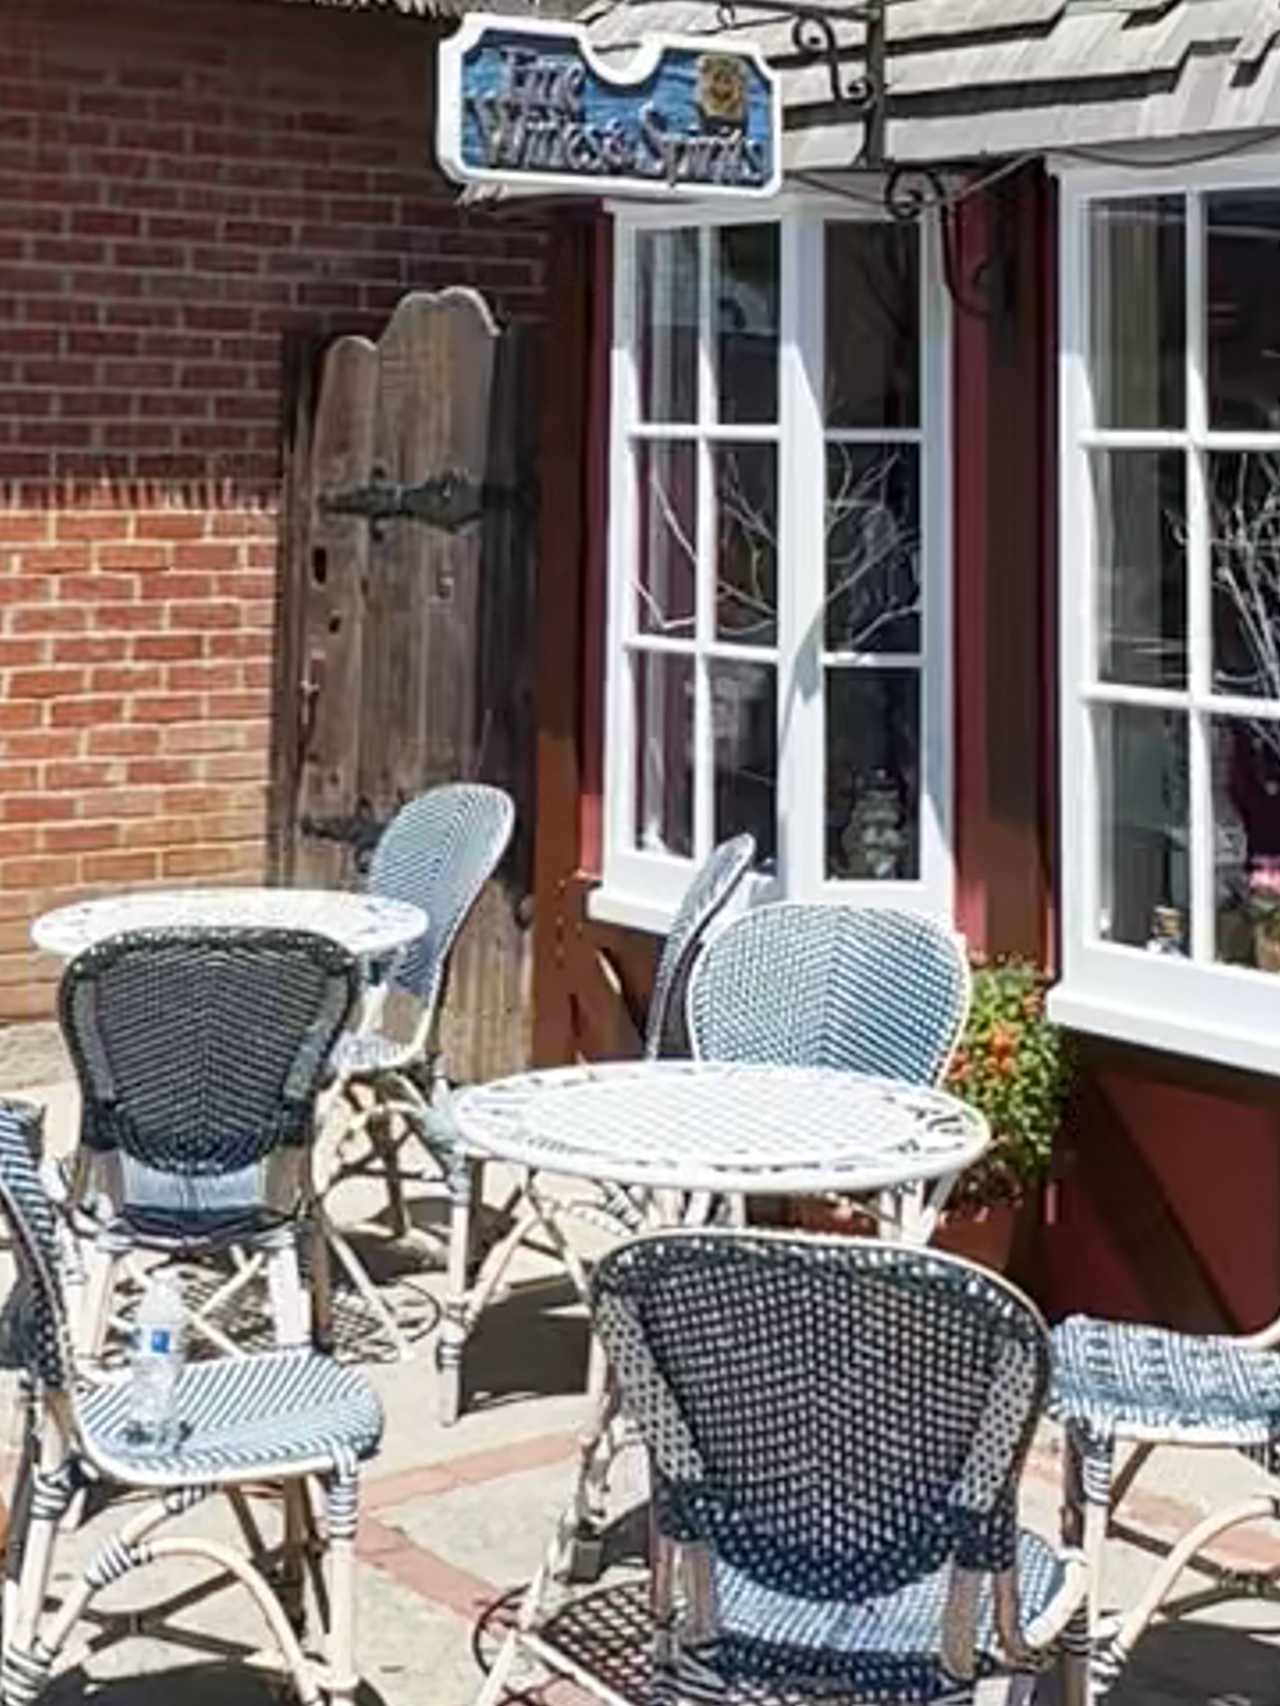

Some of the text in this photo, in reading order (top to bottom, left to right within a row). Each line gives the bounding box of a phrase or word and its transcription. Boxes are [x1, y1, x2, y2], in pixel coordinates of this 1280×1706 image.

[500, 48, 585, 112] Fine
[472, 99, 601, 170] Wines
[637, 102, 771, 189] Spirits
